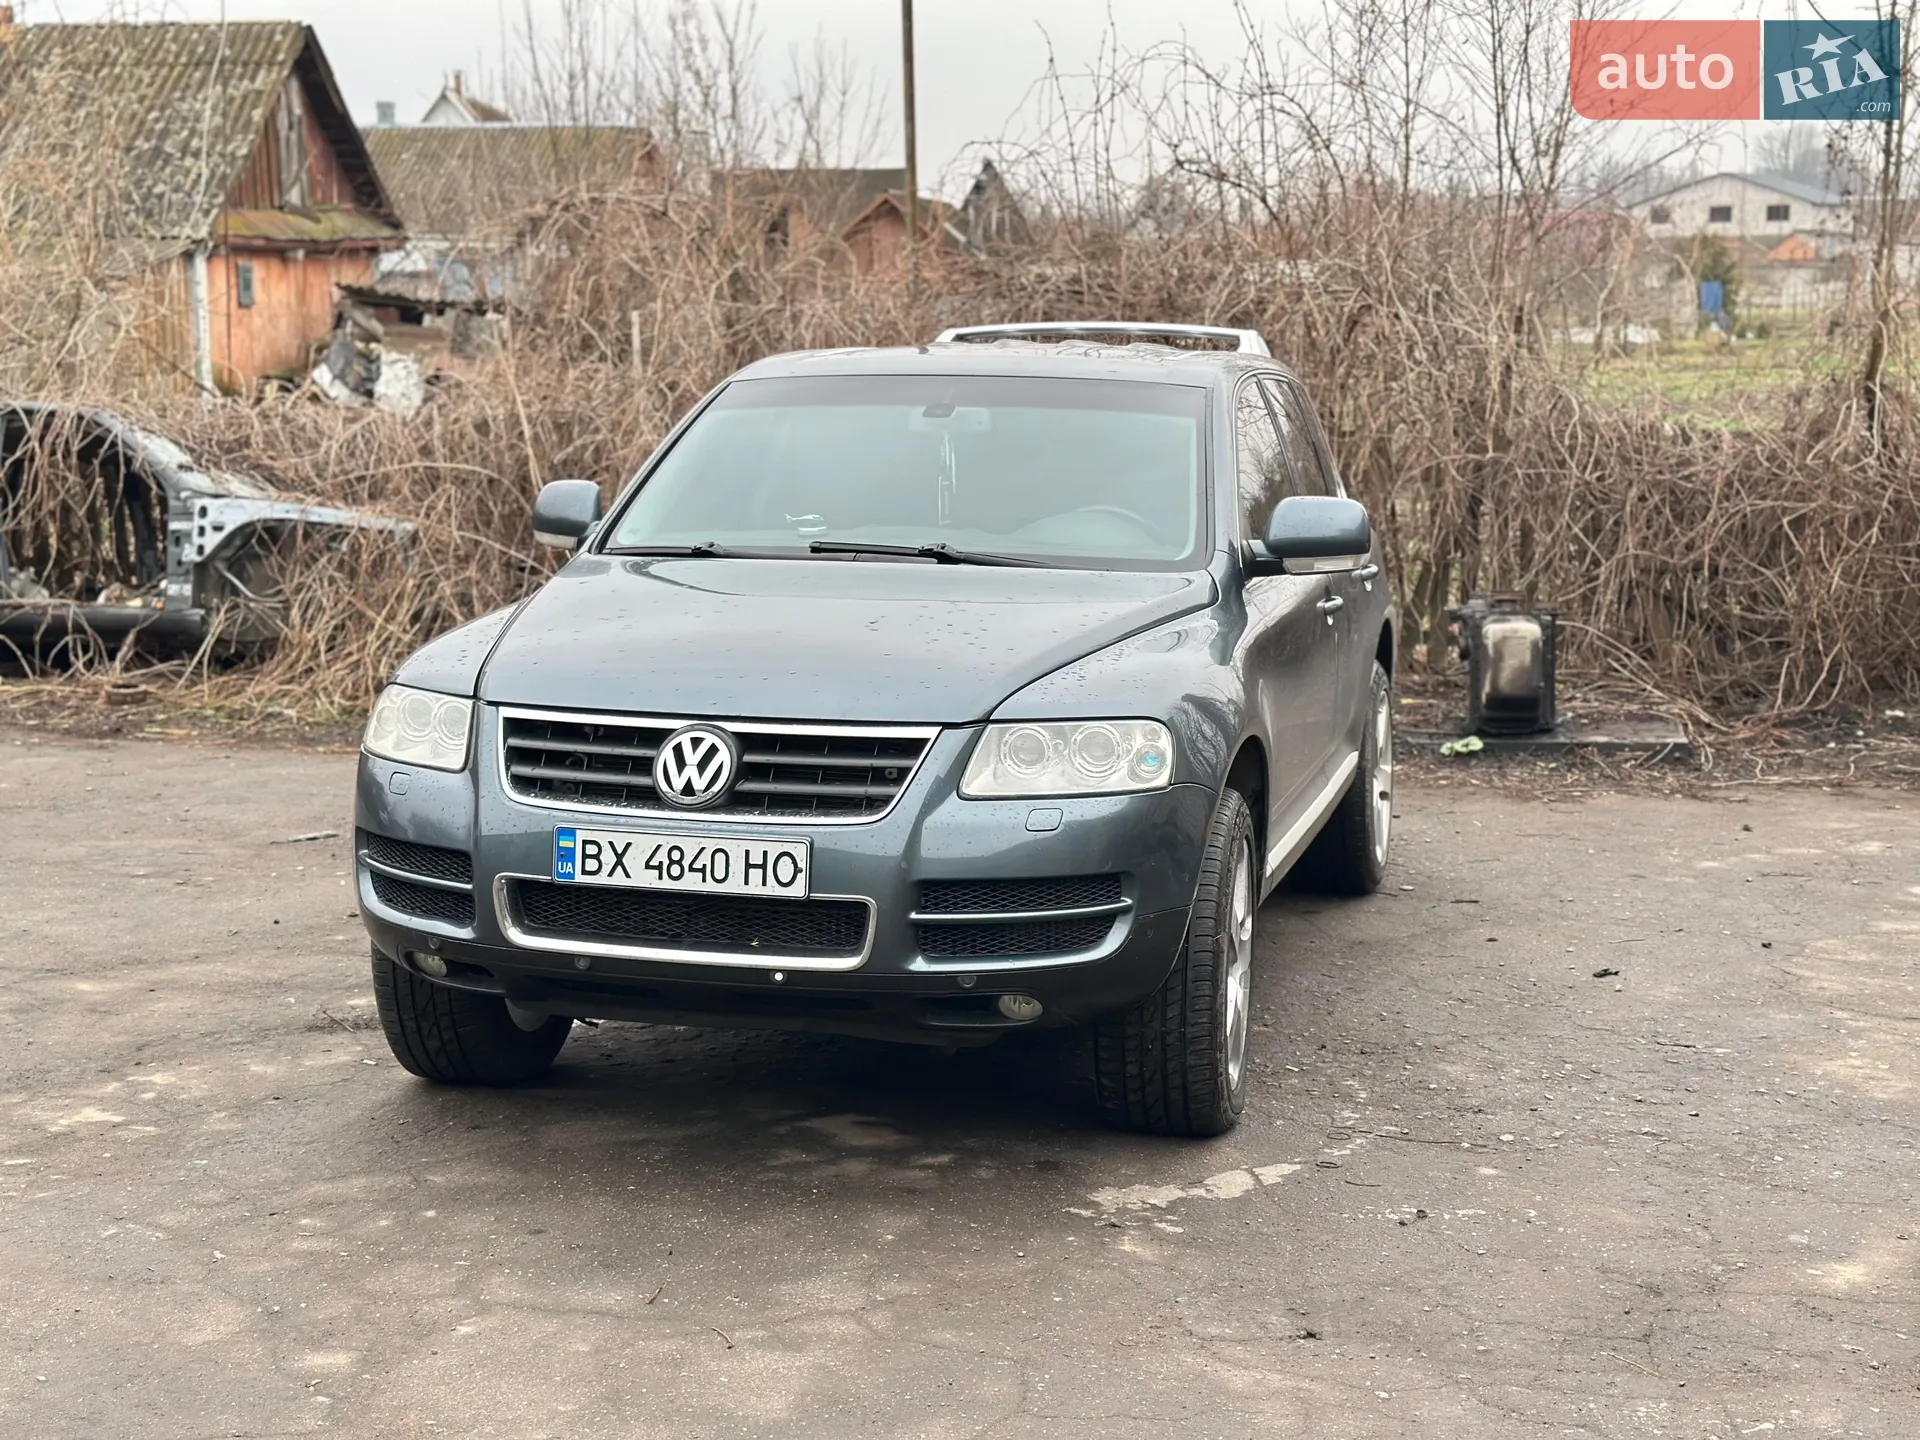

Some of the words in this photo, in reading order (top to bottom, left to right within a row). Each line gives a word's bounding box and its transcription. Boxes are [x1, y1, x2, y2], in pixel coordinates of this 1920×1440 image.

[558, 861, 574, 874] UA
[581, 839, 633, 879] BX
[644, 843, 730, 884] 4840
[744, 849, 799, 888] HO
